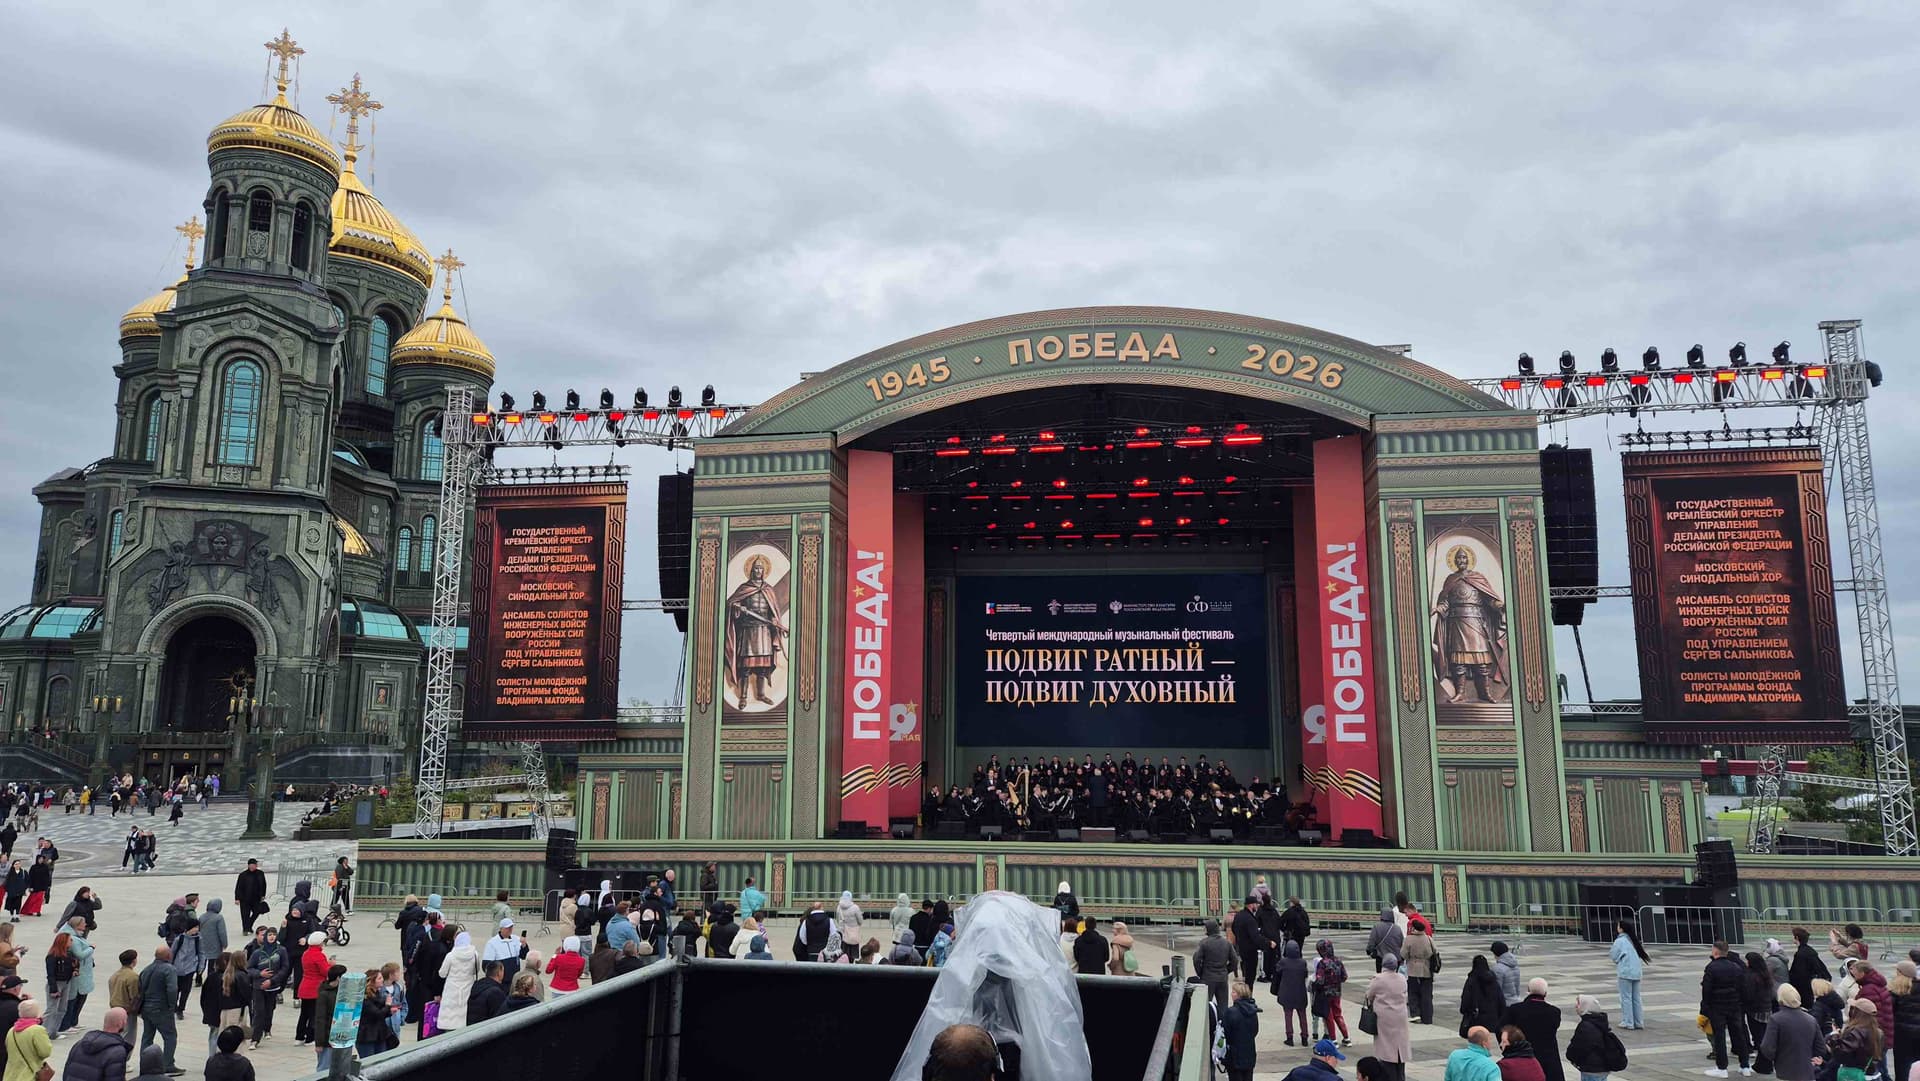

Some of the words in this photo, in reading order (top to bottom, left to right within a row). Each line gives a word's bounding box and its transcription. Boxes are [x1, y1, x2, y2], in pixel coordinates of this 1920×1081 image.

[865, 356, 953, 402] 1945
[1007, 331, 1181, 366] ПОБЕДА
[1241, 344, 1346, 390] 2026
[1676, 497, 1774, 510] ГОСУДАРСТВЕННЫЙ
[1740, 509, 1785, 518] ОРКЕСТР
[1694, 520, 1759, 530] УПРАВЛЕНИЯ
[512, 526, 586, 537] ГОСУДАРСТВЕННЫЙ
[1673, 532, 1715, 542] ДЕЛАМИ
[1718, 530, 1782, 540] ПРЕЗИДЕНТА
[560, 536, 593, 544] ОРКЕСТР
[524, 546, 573, 554] УПРАВЛЕНИЯ
[1664, 541, 1730, 552] РОССИЙСКОЙ
[1731, 541, 1793, 551] ФЕДЕРАЦИИ
[507, 556, 539, 565] ДЕЛАМИ
[541, 555, 589, 563] ПРЕЗИДЕНТА
[500, 563, 549, 573] РОССИЙСКОЙ
[550, 564, 596, 573] ФЕДЕРАЦИИ
[1695, 561, 1765, 572] МОСКОВСКИЙ
[1680, 572, 1760, 584] СИНОДАЛЬНЫЙ
[1761, 573, 1782, 582] ХОР
[520, 581, 573, 591] МОСКОВСКИЙ
[508, 591, 567, 602] СИНОДАЛЬНЫЙ
[569, 592, 585, 600] ХОР
[1676, 595, 1733, 605] АНСАМБЛЬ
[1736, 595, 1791, 604] СОЛИСТОВ
[503, 611, 546, 620] АНСАМБЛЬ
[547, 610, 589, 619] СОЛИСТОВ
[1679, 606, 1752, 616] ИНЖЕНЕРНЫХ
[1755, 604, 1789, 615] ВОЙСК
[503, 620, 559, 629] ИНЖЕНЕРНЫХ
[560, 619, 586, 628] ВОЙСК
[1766, 616, 1788, 626] СИЛ
[567, 629, 584, 638] СИЛ
[985, 628, 1036, 642] Четвертый
[1037, 629, 1113, 642] международный
[1114, 628, 1180, 642] музыкальный
[1181, 627, 1235, 641] фестиваль
[1715, 628, 1758, 637] РОССИИ
[528, 640, 560, 648] РОССИИ
[853, 550, 889, 740] ПОБЕДА!
[1327, 542, 1366, 743] ПОБЕДА!
[1687, 640, 1709, 650] ПОД
[1712, 639, 1788, 649] УПРАВЛЕНИЕМ
[505, 650, 522, 658] ПОД
[524, 649, 582, 658] УПРАВЛЕНИЕМ
[1683, 650, 1721, 660] СЕРГЕЯ
[1724, 650, 1795, 660] САЛЬНИКОВА
[501, 659, 531, 668] СЕРГЕЯ
[531, 659, 584, 667] САЛЬНИКОВА
[985, 649, 1088, 677] ПОДВИГ
[1093, 641, 1205, 672] РАТНЫЙ
[1680, 672, 1728, 681] СОЛИСТЫ
[496, 678, 533, 686] СОЛИСТЫ
[503, 687, 551, 696] ПРОГРАММЫ
[552, 687, 580, 696] ФОНДА
[985, 680, 1085, 708] ПОДВИГ
[1089, 674, 1237, 708] ДУХОВНЫЙ
[1691, 683, 1755, 692] ПРОГРАММЫ
[1757, 683, 1793, 692] ФОНДА
[496, 697, 543, 706] ВЛАДИМИРА
[544, 696, 585, 704] МАТОРИНА
[1684, 694, 1746, 704] ВЛАДИМИРА
[1748, 693, 1802, 703] МАТОРИНА
[889, 704, 917, 741] 9
